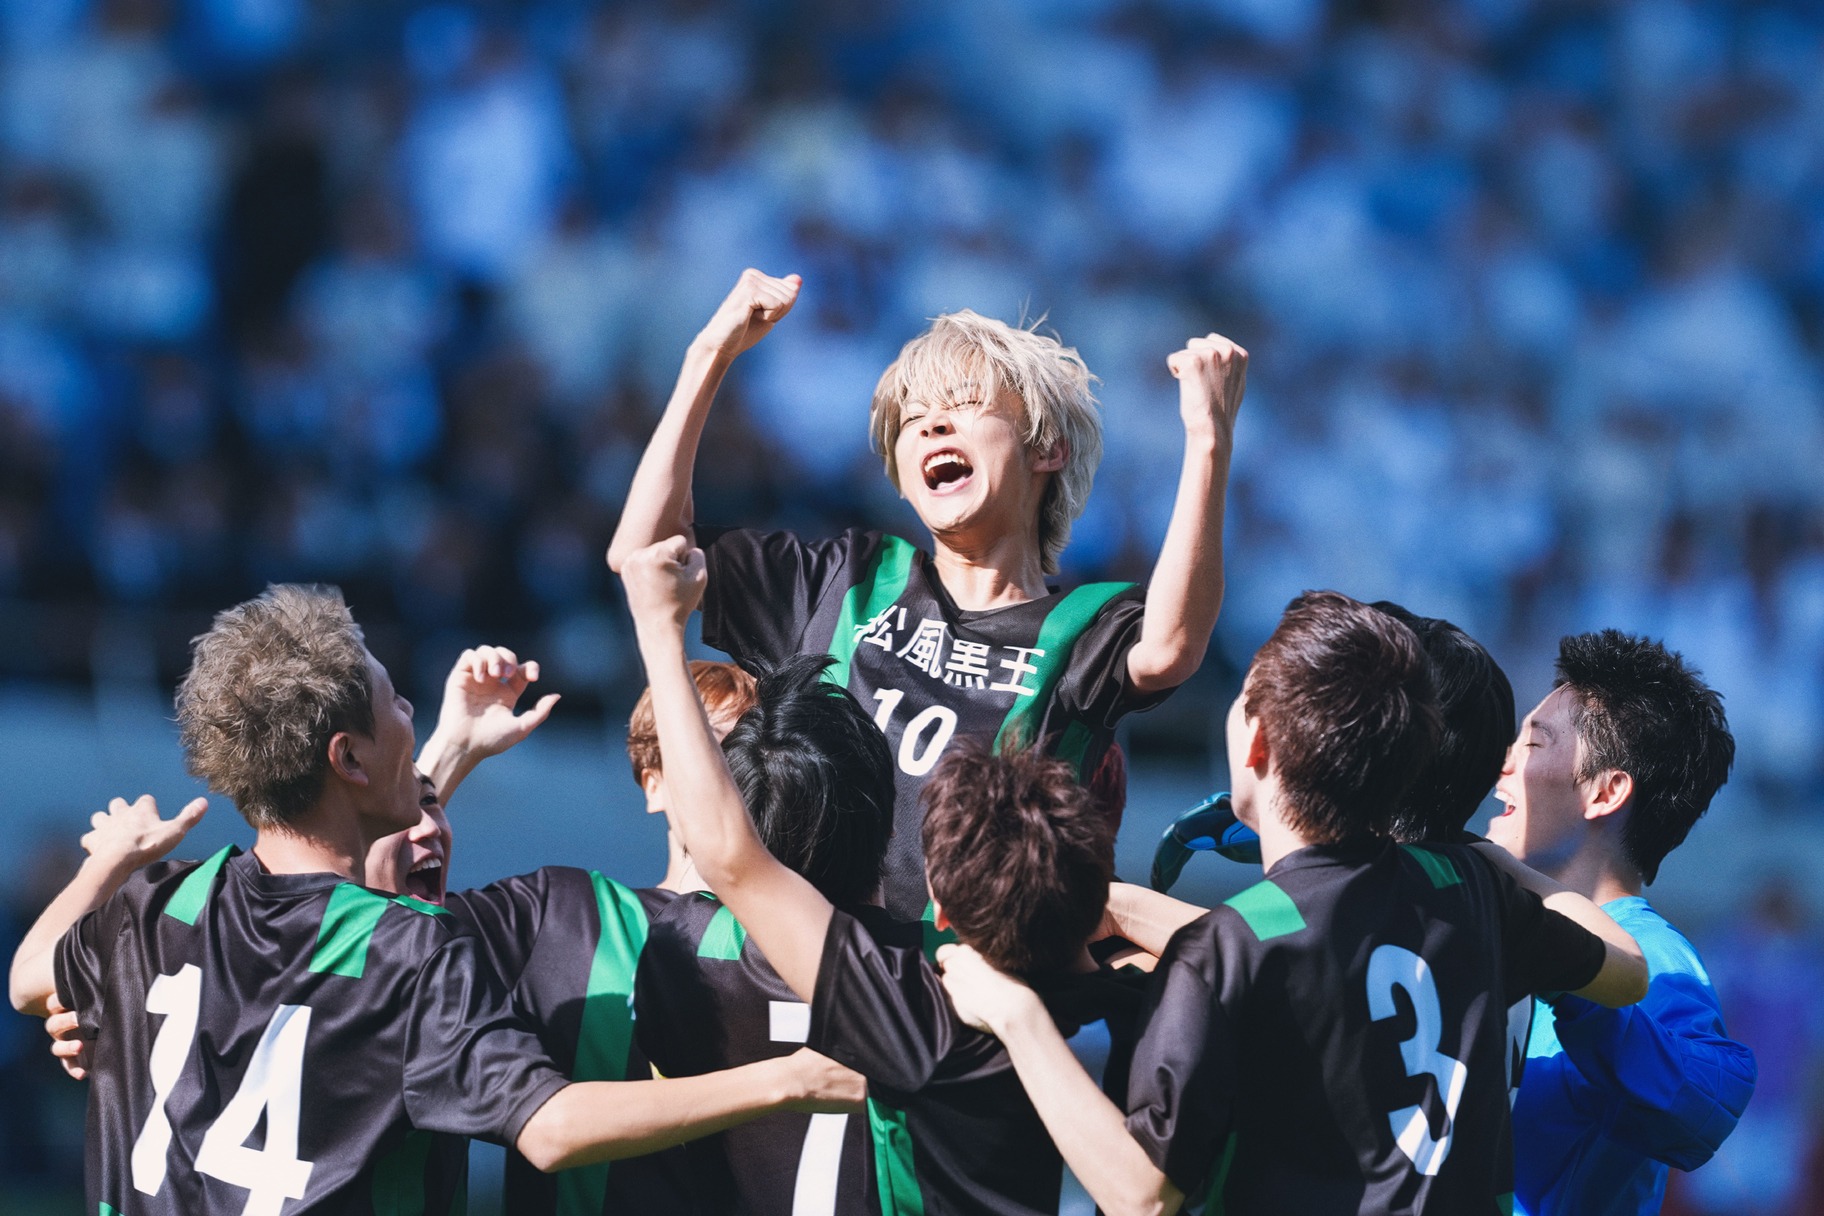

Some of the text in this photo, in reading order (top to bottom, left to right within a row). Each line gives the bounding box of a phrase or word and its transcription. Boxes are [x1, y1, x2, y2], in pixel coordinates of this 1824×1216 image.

[853, 605, 1045, 696] 松風黒王
[873, 688, 957, 776] 10
[131, 963, 314, 1216] 14
[1366, 944, 1468, 1176] 3
